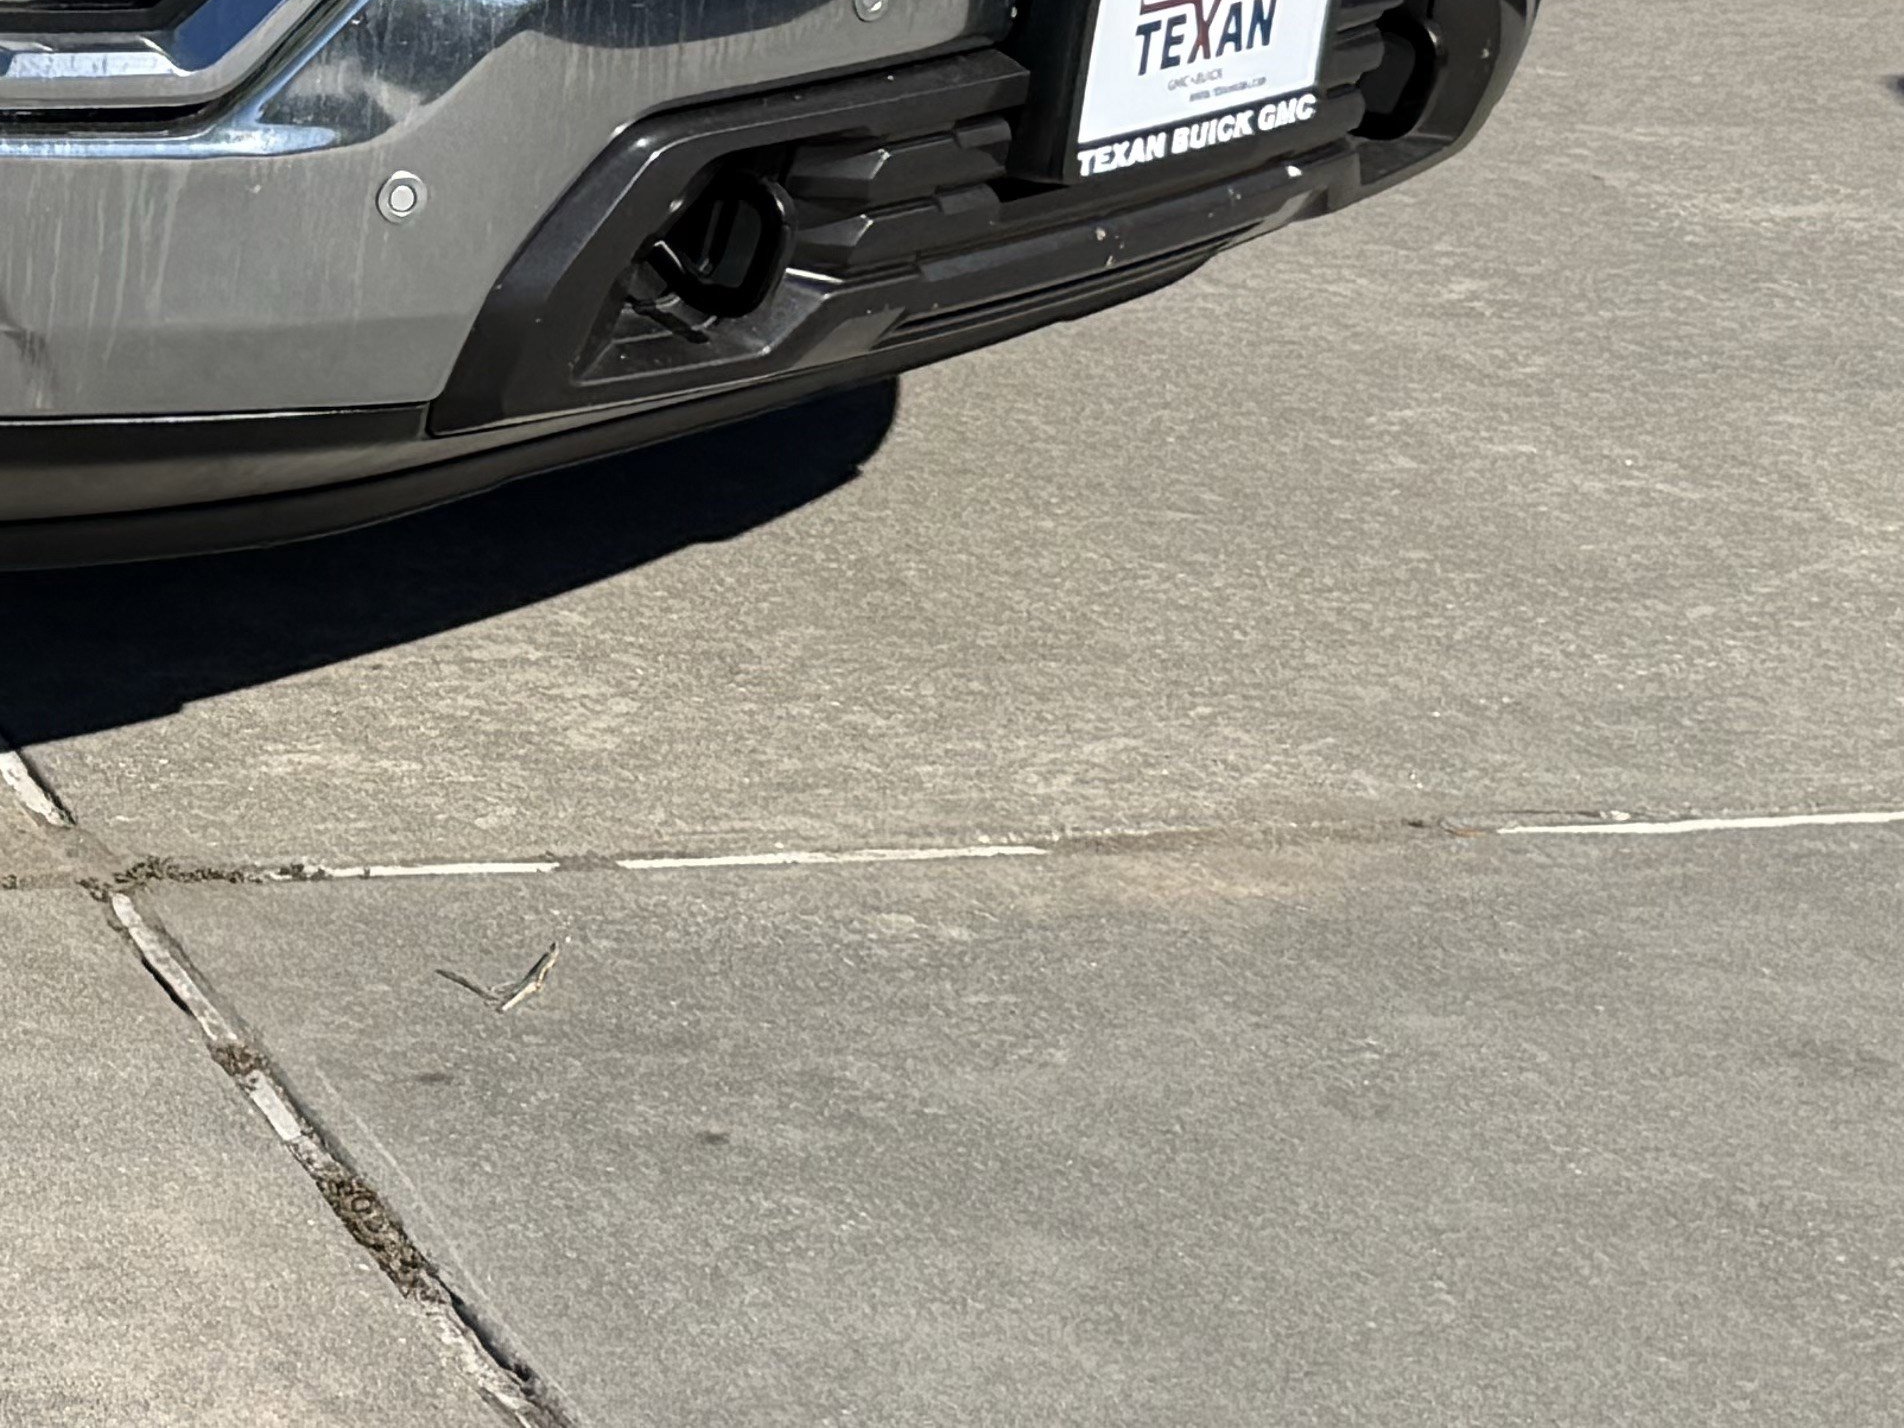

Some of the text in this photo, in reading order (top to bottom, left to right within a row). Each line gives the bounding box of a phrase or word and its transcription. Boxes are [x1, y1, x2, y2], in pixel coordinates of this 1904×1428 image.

[1077, 93, 1317, 177] TEXAN BUICK GMC
